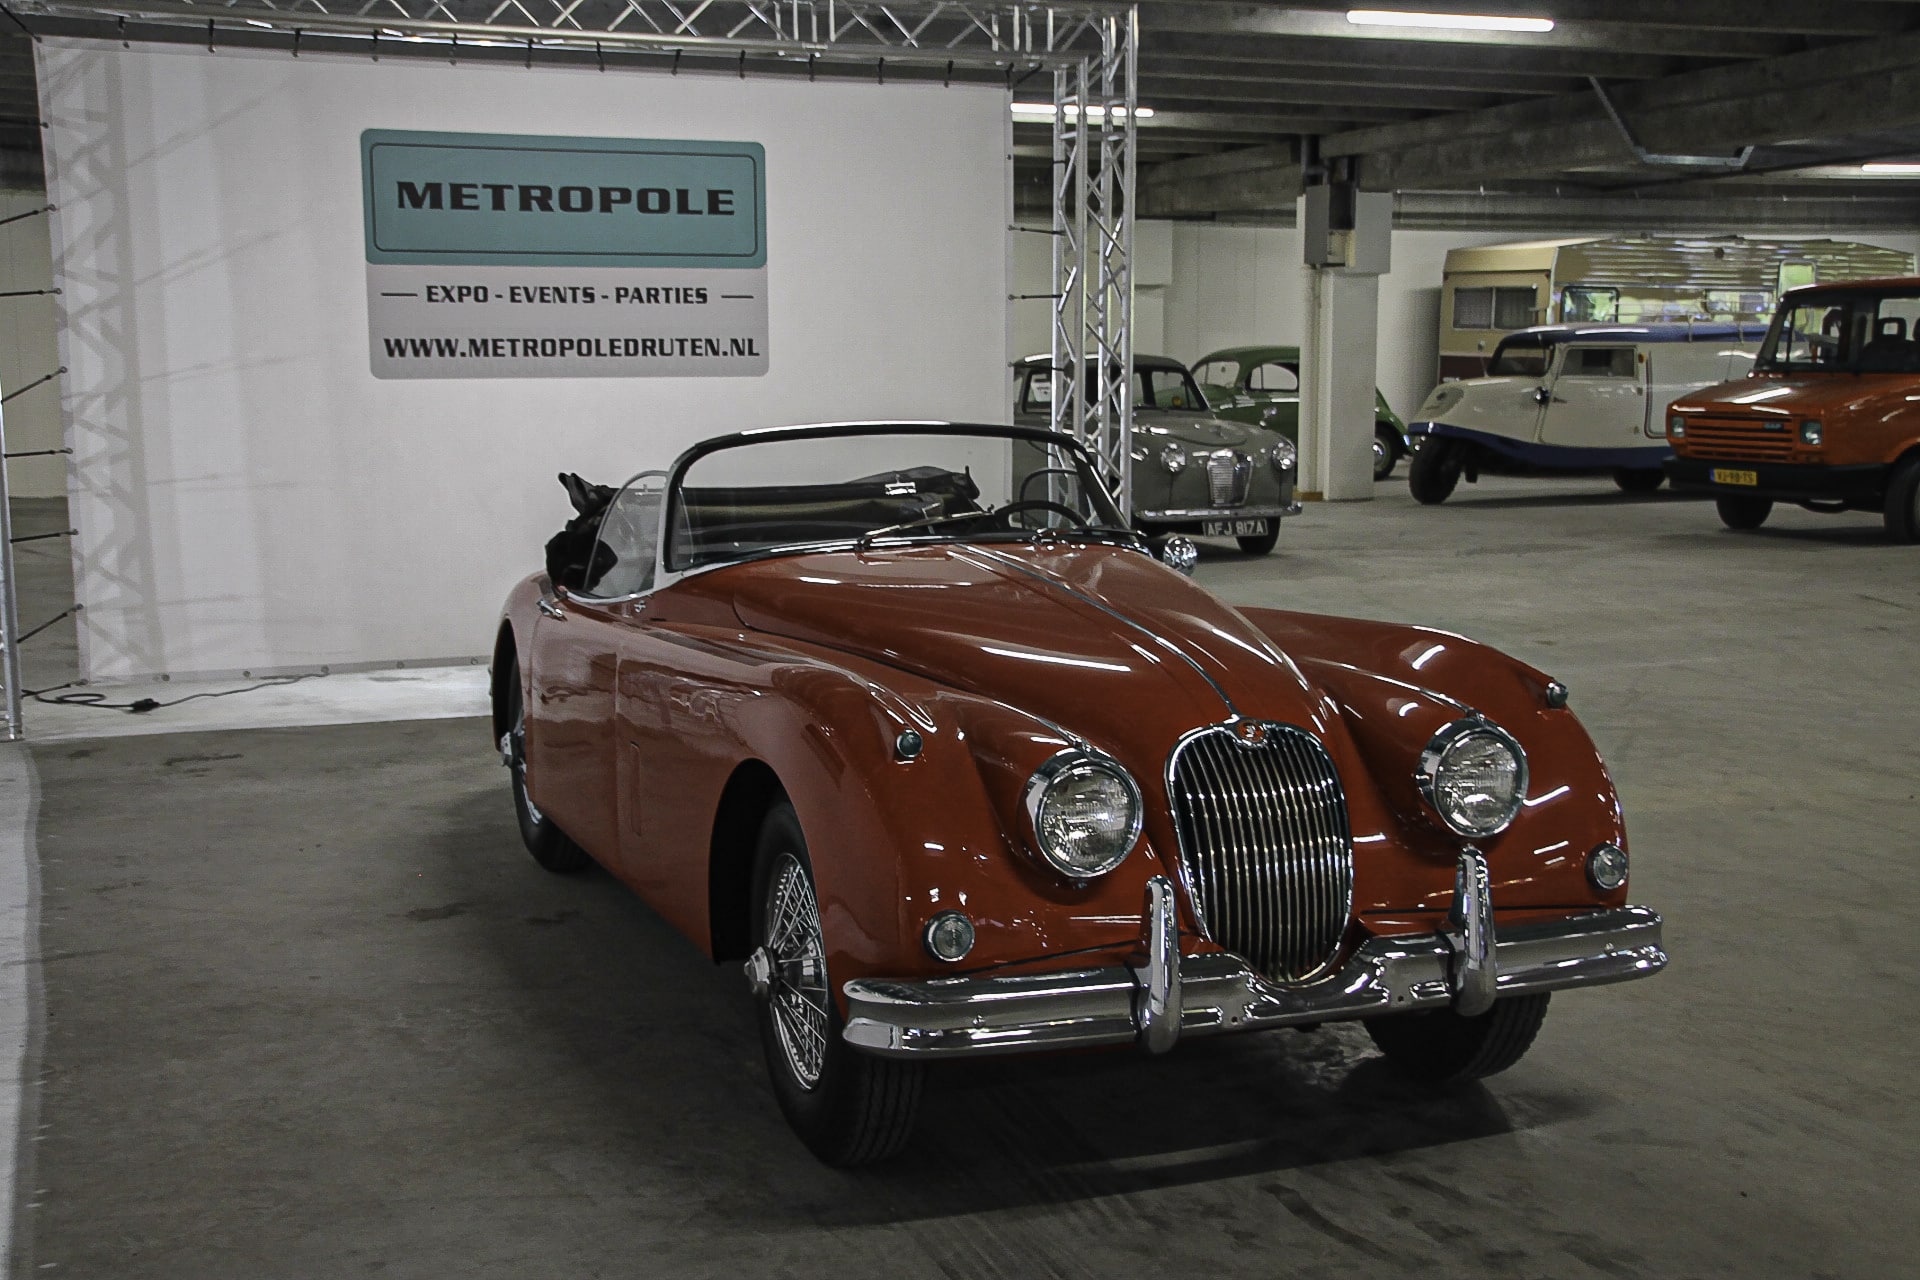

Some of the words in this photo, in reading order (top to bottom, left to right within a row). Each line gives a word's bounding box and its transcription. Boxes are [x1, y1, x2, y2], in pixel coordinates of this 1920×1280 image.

[396, 181, 735, 216] METROPOLE
[426, 285, 489, 304] EXPO
[509, 286, 596, 305] EVENTS
[615, 286, 708, 305] PARTIES
[383, 338, 760, 358] WWW.METROPOLEDRUTEN.NL
[1207, 521, 1233, 537] AFJ
[1235, 519, 1264, 536] 817A
